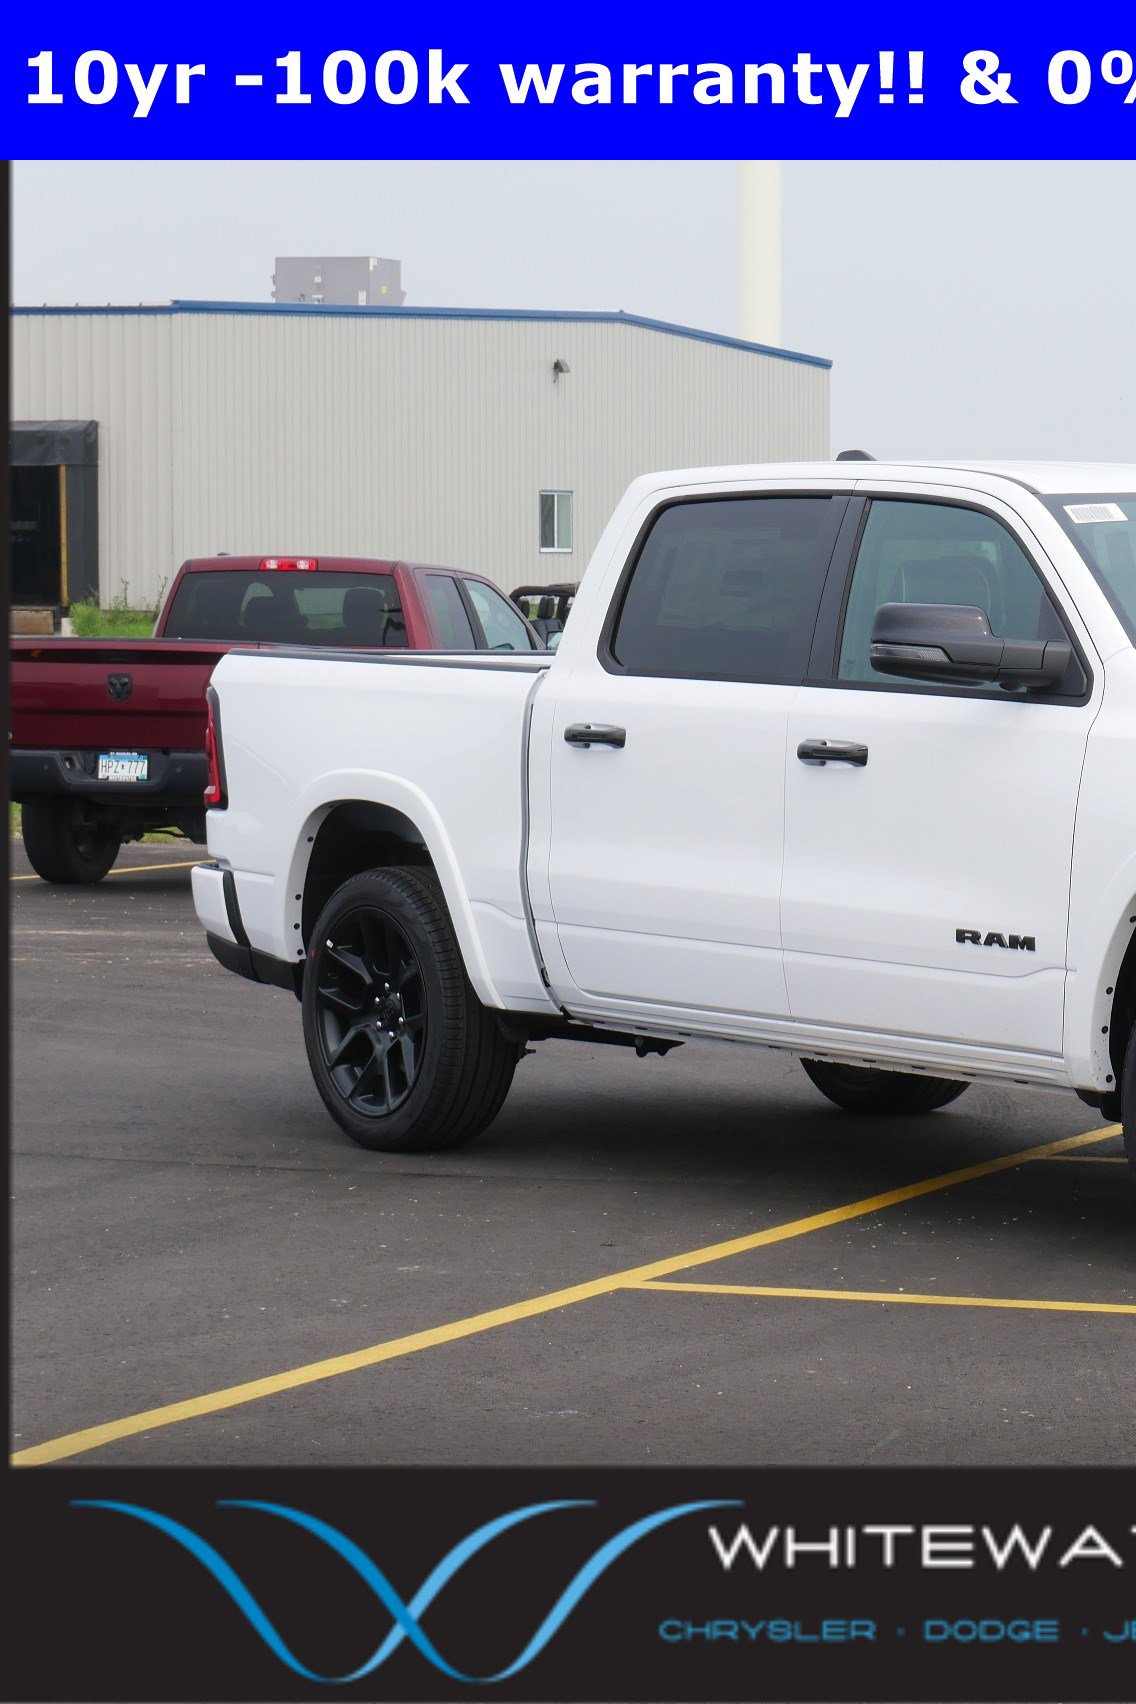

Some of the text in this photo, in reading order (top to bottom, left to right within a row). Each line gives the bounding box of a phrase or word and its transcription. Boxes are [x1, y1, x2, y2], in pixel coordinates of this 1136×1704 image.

[101, 760, 146, 774] HPZ 777
[956, 928, 1036, 952] RAM
